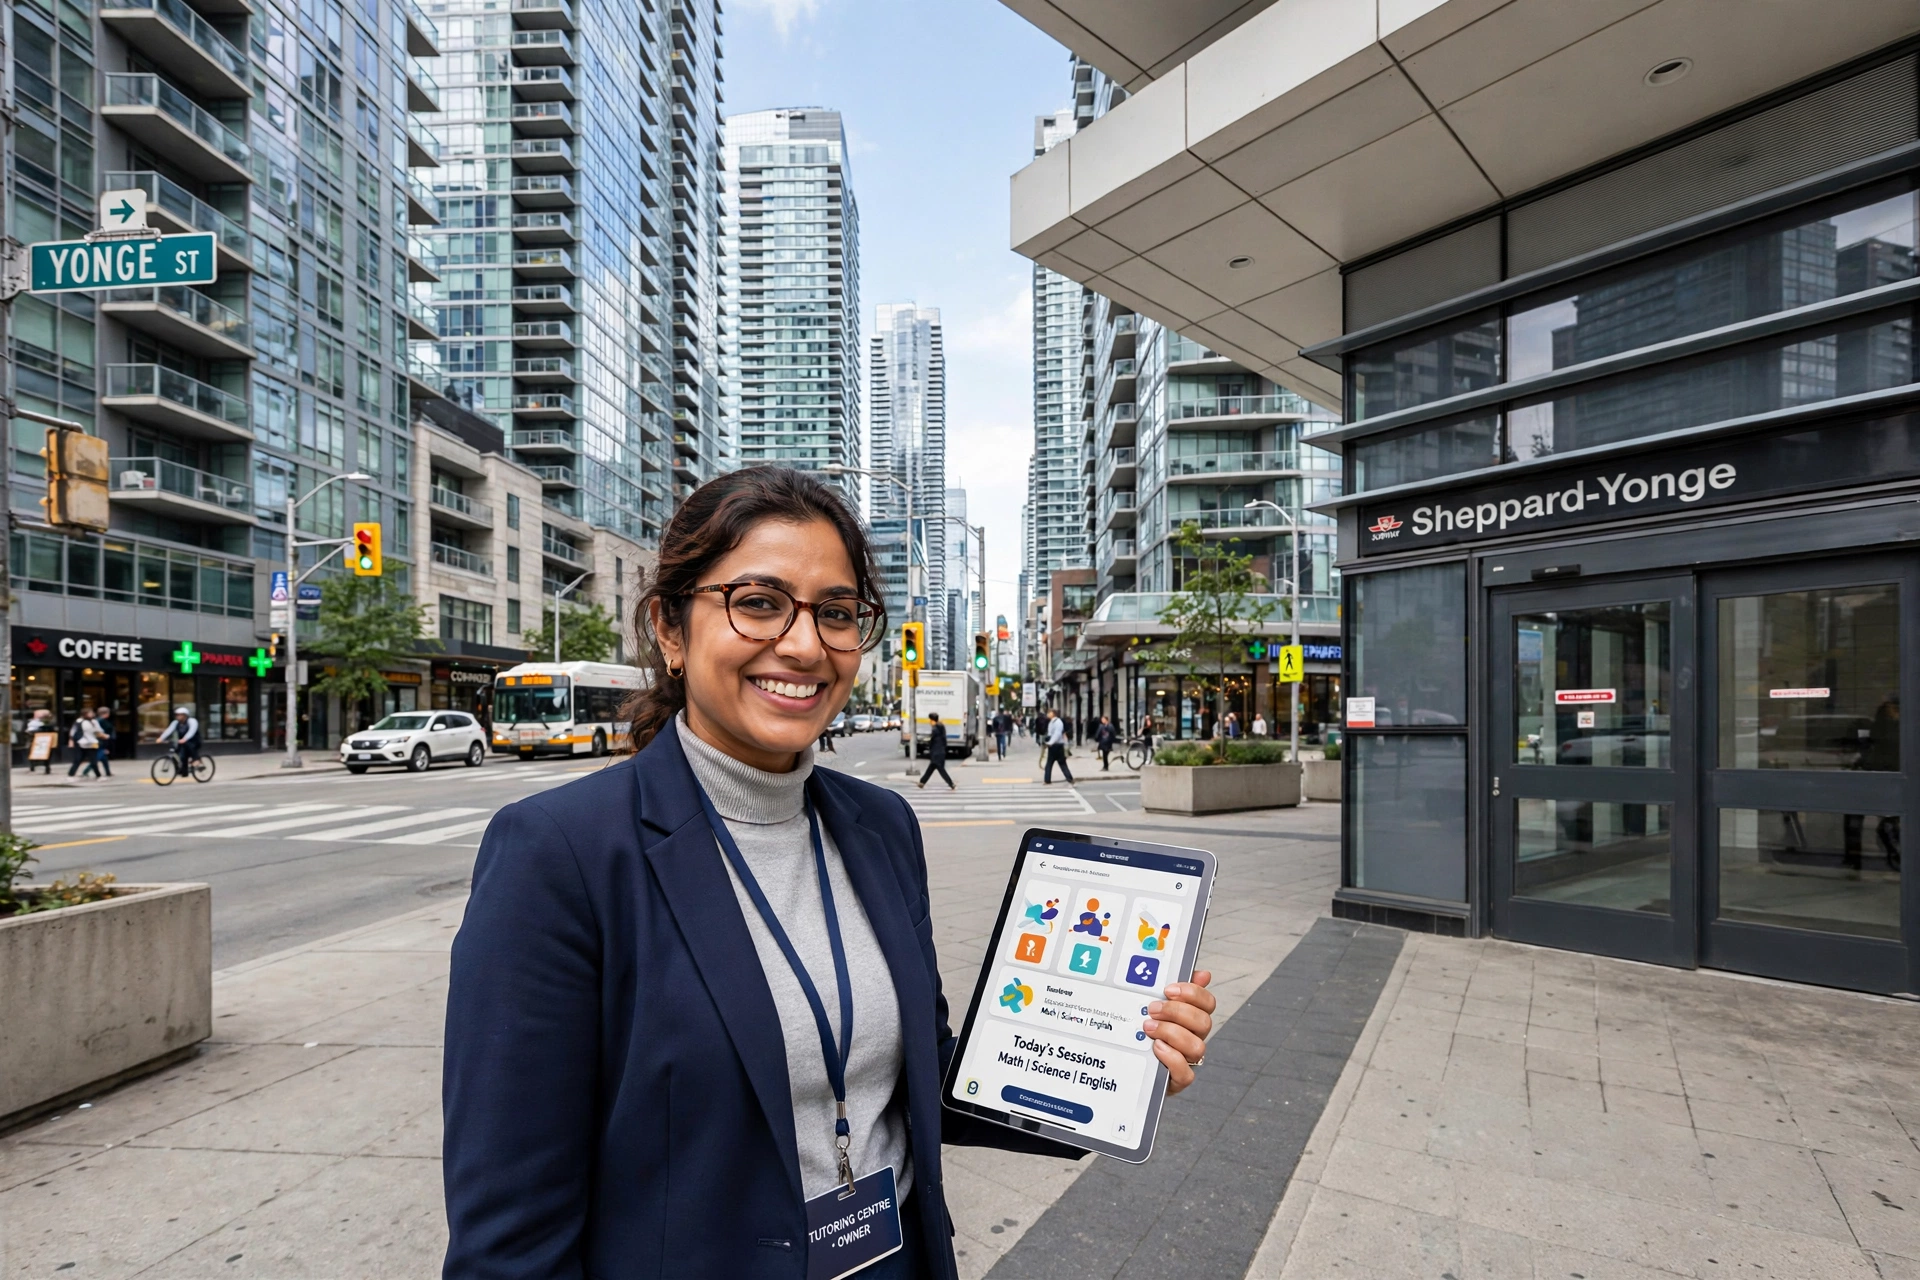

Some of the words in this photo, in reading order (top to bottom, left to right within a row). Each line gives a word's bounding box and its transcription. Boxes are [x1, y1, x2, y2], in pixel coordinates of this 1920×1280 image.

[48, 243, 157, 285] YONGE
[175, 250, 200, 275] ST
[1411, 462, 1737, 536] Sheppard-Yonge
[58, 637, 143, 662] COFFEE
[997, 1051, 1024, 1068] Math
[1031, 1060, 1071, 1080] Science
[1079, 1072, 1118, 1092] English
[1013, 1034, 1055, 1057] Today's
[1056, 1046, 1106, 1070] Sessions
[808, 1214, 856, 1243] TUTORING
[857, 1198, 891, 1221] CENTRE
[837, 1223, 871, 1248] OWNER
